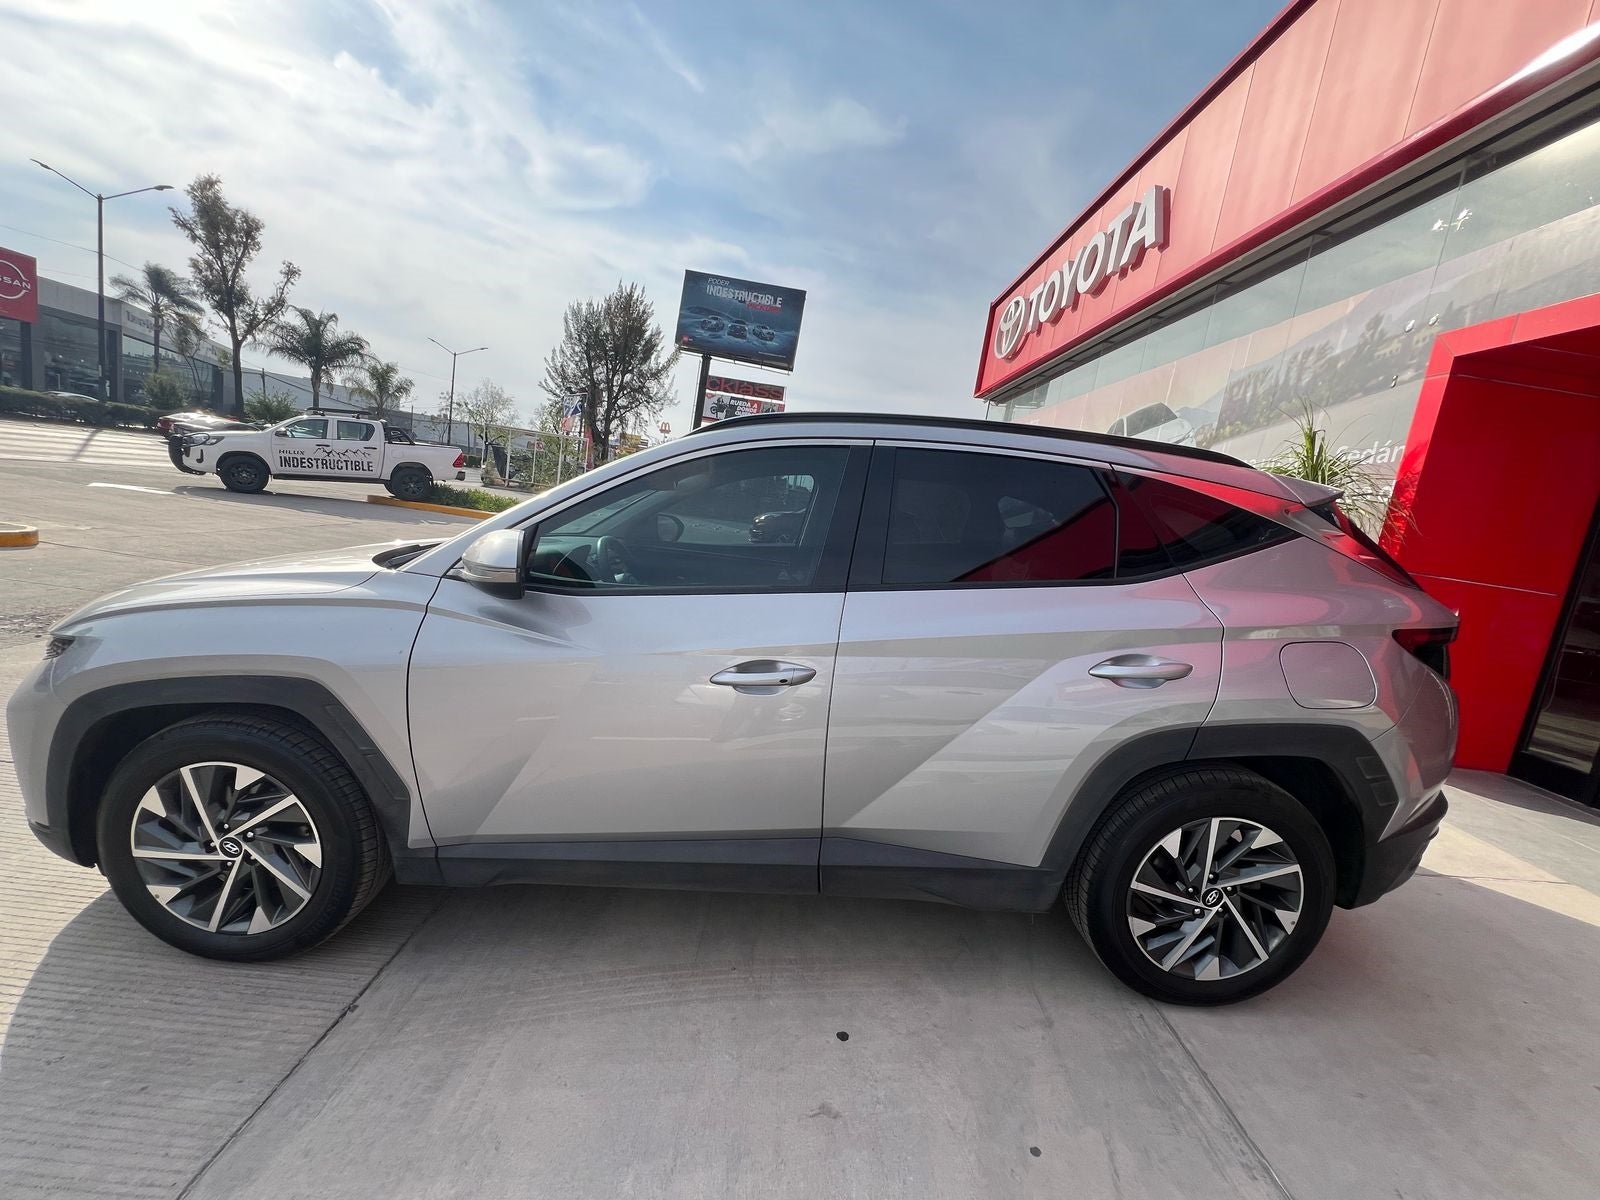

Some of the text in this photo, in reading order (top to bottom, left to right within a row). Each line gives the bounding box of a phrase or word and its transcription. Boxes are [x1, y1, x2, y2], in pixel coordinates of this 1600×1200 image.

[1027, 184, 1163, 333] TOYOTA
[0, 275, 31, 290] SAN
[707, 277, 730, 286] PODER
[706, 284, 783, 308] INDESTRUCTIBLE
[730, 399, 752, 408] RUEDA
[279, 455, 374, 472] INDESTRUCTIBLE
